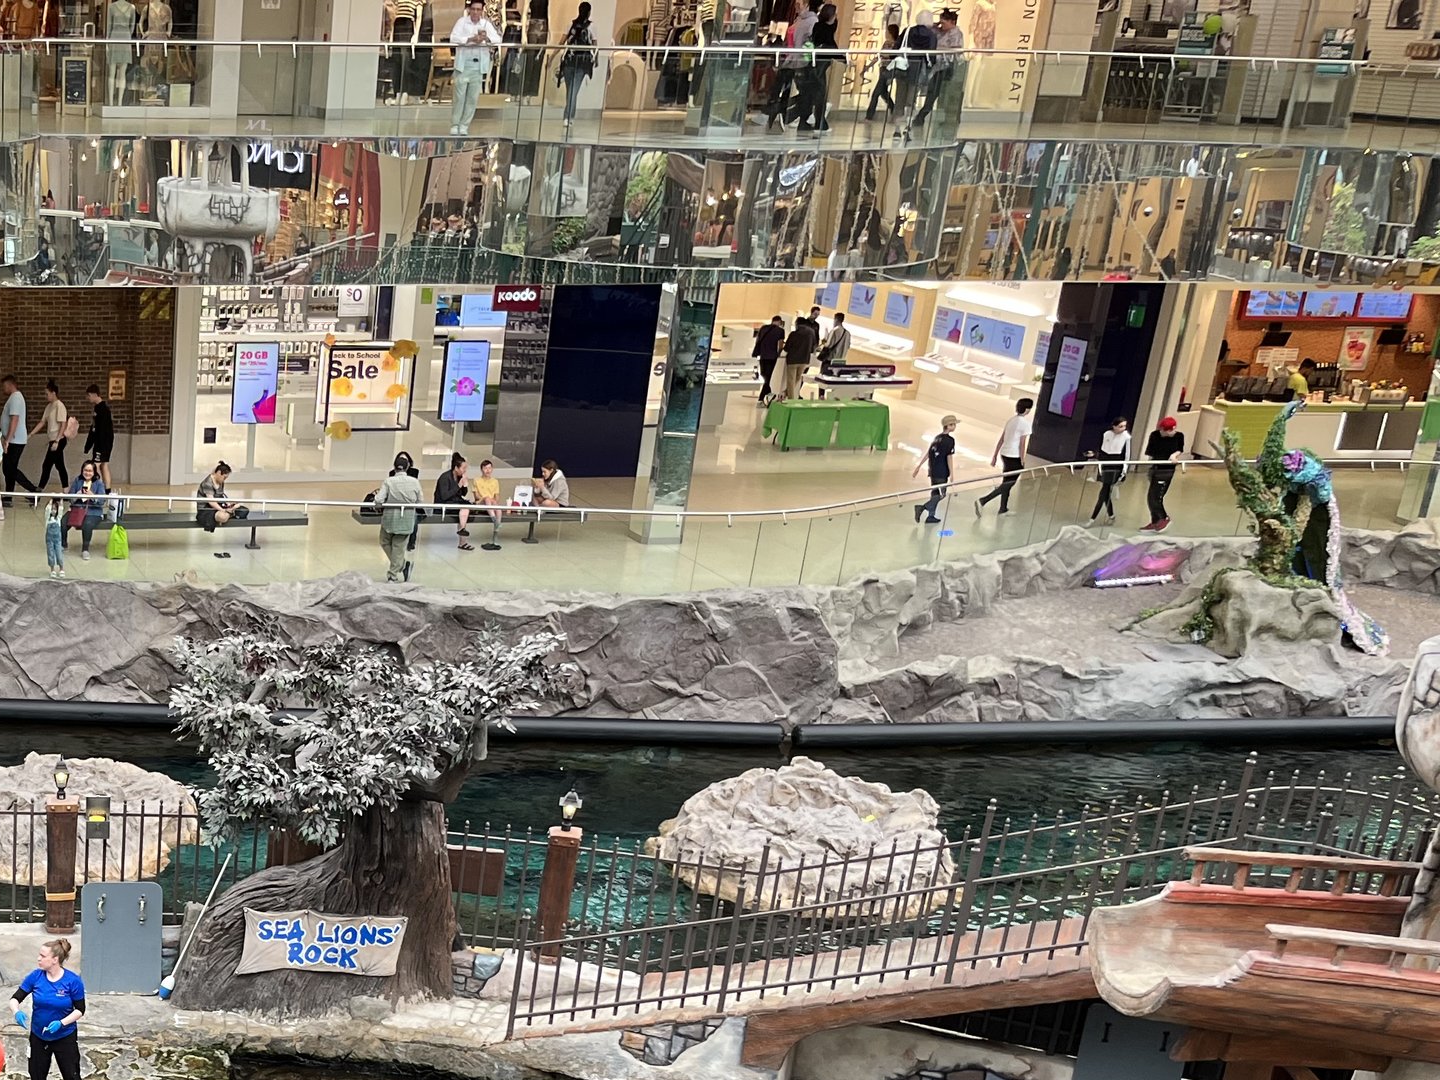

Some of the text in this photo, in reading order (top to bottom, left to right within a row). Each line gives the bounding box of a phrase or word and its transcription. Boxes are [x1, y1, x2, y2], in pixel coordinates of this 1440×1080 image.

[346, 288, 363, 302] $0
[240, 351, 269, 360] 20 GB
[330, 359, 379, 380] Sale
[257, 919, 401, 947] SEA LIONS'
[286, 942, 359, 969] ROCK
